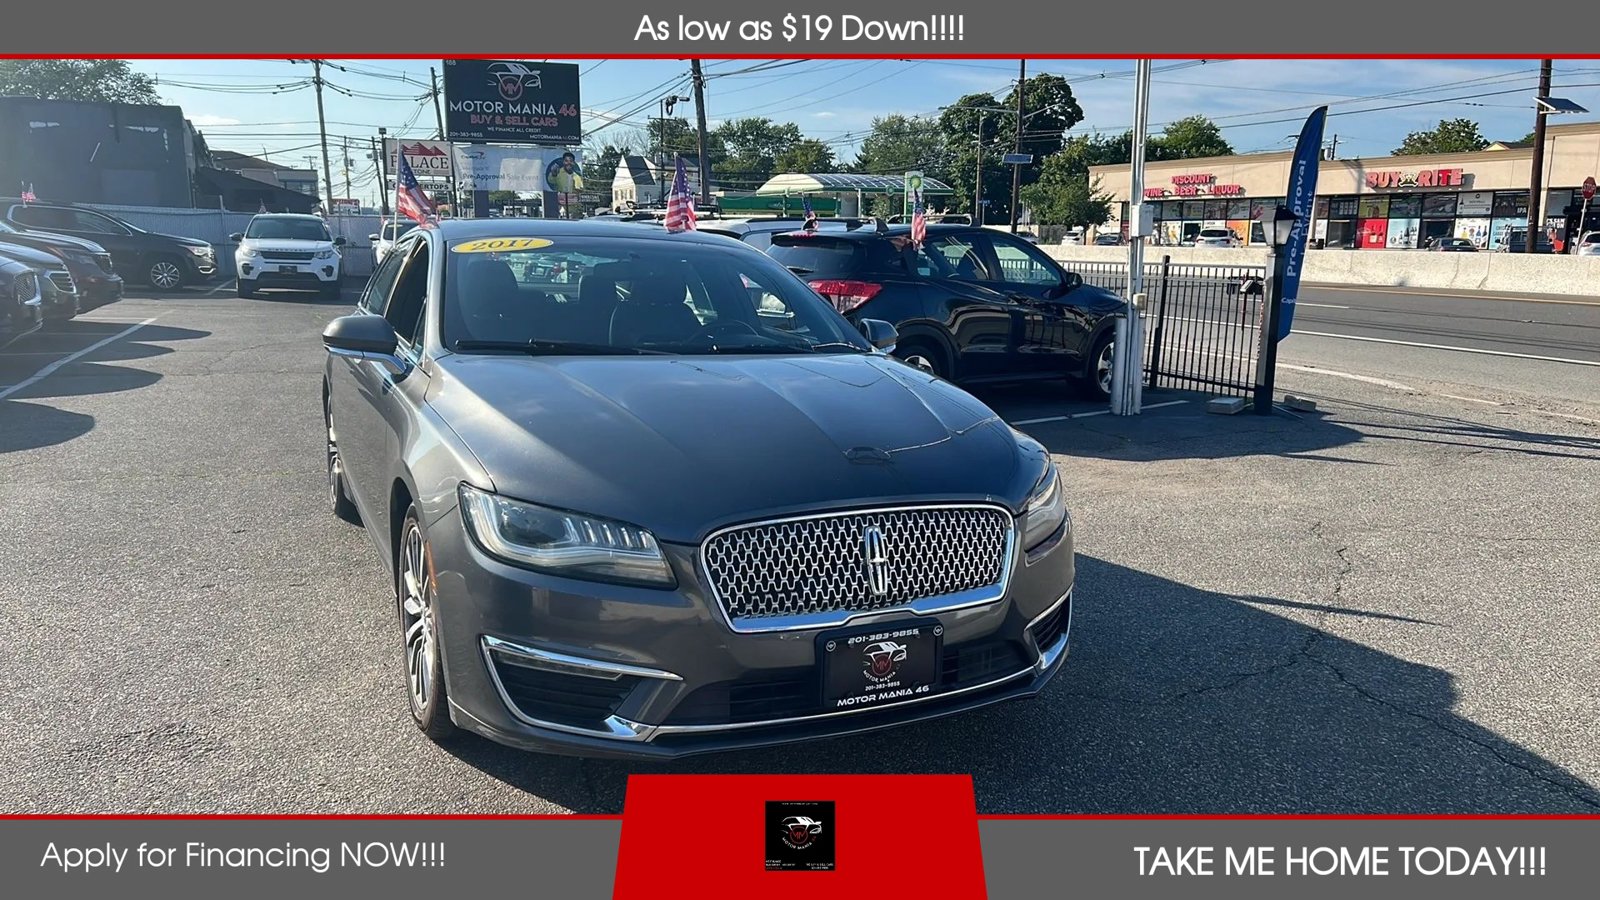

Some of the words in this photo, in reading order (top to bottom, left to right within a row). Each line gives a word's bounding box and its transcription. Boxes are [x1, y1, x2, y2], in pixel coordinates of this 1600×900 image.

[449, 100, 504, 114] MOTOR
[508, 103, 557, 116] MANIA
[559, 103, 577, 117] 46
[470, 114, 493, 124] BUY
[494, 115, 503, 125] &
[505, 116, 530, 126] SELL
[531, 117, 558, 127] CARS
[390, 155, 449, 169] PLACE
[462, 173, 505, 181] Pre-Approval
[1171, 173, 1212, 185] DISCOUNT
[1365, 171, 1401, 188] BUY
[1417, 168, 1463, 187] RITE
[1144, 187, 1165, 198] WINE
[1174, 185, 1198, 196] BEER
[1207, 184, 1241, 195] LIQUOR
[1583, 183, 1596, 191] STOP
[1286, 159, 1307, 277] Pre-Approval
[471, 239, 533, 251] 2017
[847, 628, 919, 644] 201-383-9855
[863, 670, 879, 683] MOTOR
[879, 671, 896, 682] MANIA
[837, 694, 876, 707] MOTOR
[878, 688, 913, 700] MANIA
[915, 684, 930, 693] 46
